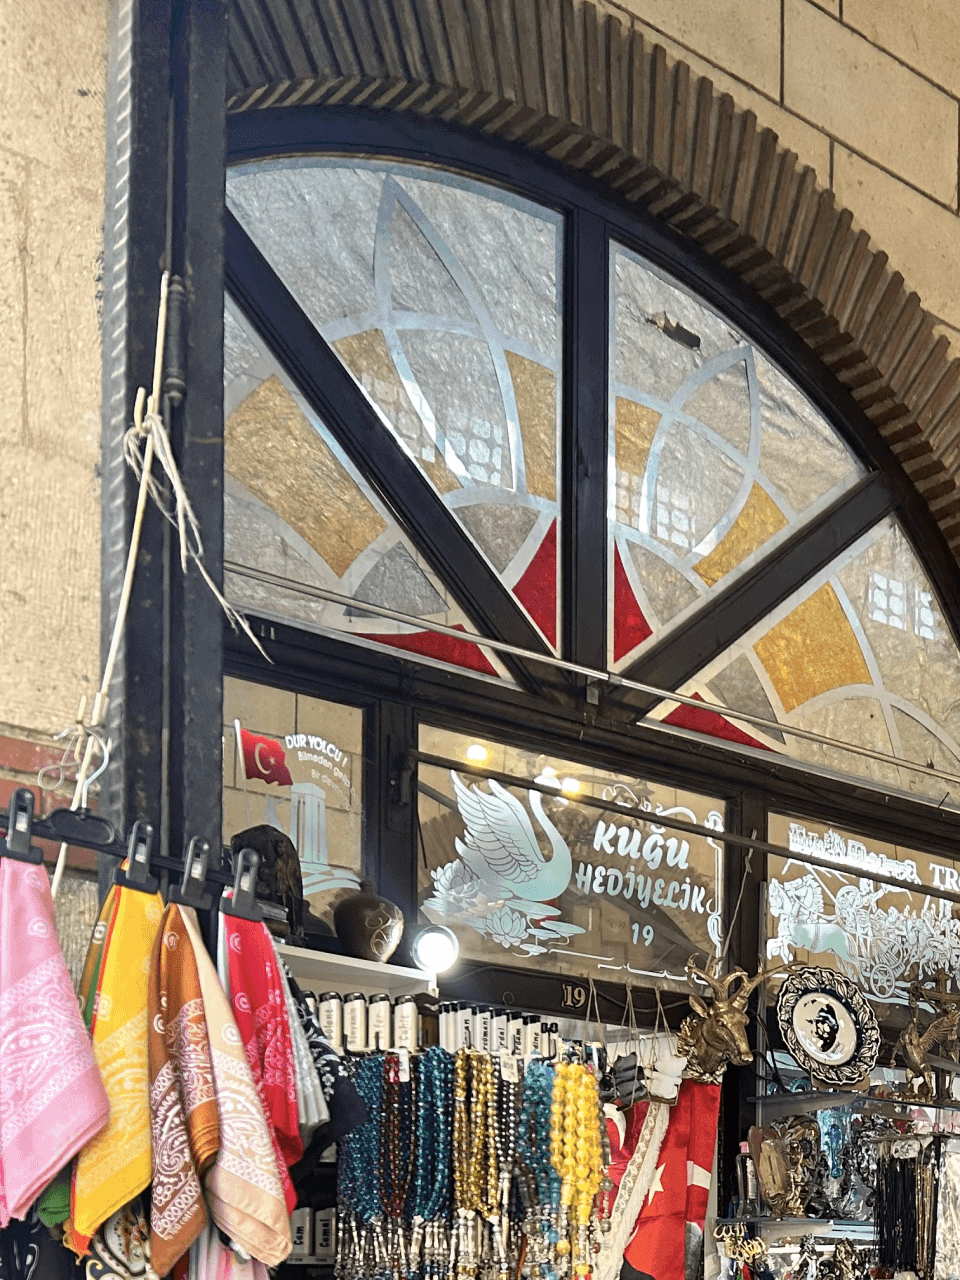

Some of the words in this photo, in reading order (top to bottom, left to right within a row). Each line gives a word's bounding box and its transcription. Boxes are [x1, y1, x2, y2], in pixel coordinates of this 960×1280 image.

[285, 734, 307, 749] DUR
[308, 735, 342, 762] YOLCU
[593, 820, 690, 870] KUĞU
[575, 862, 706, 914] HEDİYELİK
[632, 923, 654, 947] 19
[562, 984, 586, 1009] 19
[293, 1226, 304, 1246] Cem
[319, 1218, 331, 1248] Cemal
